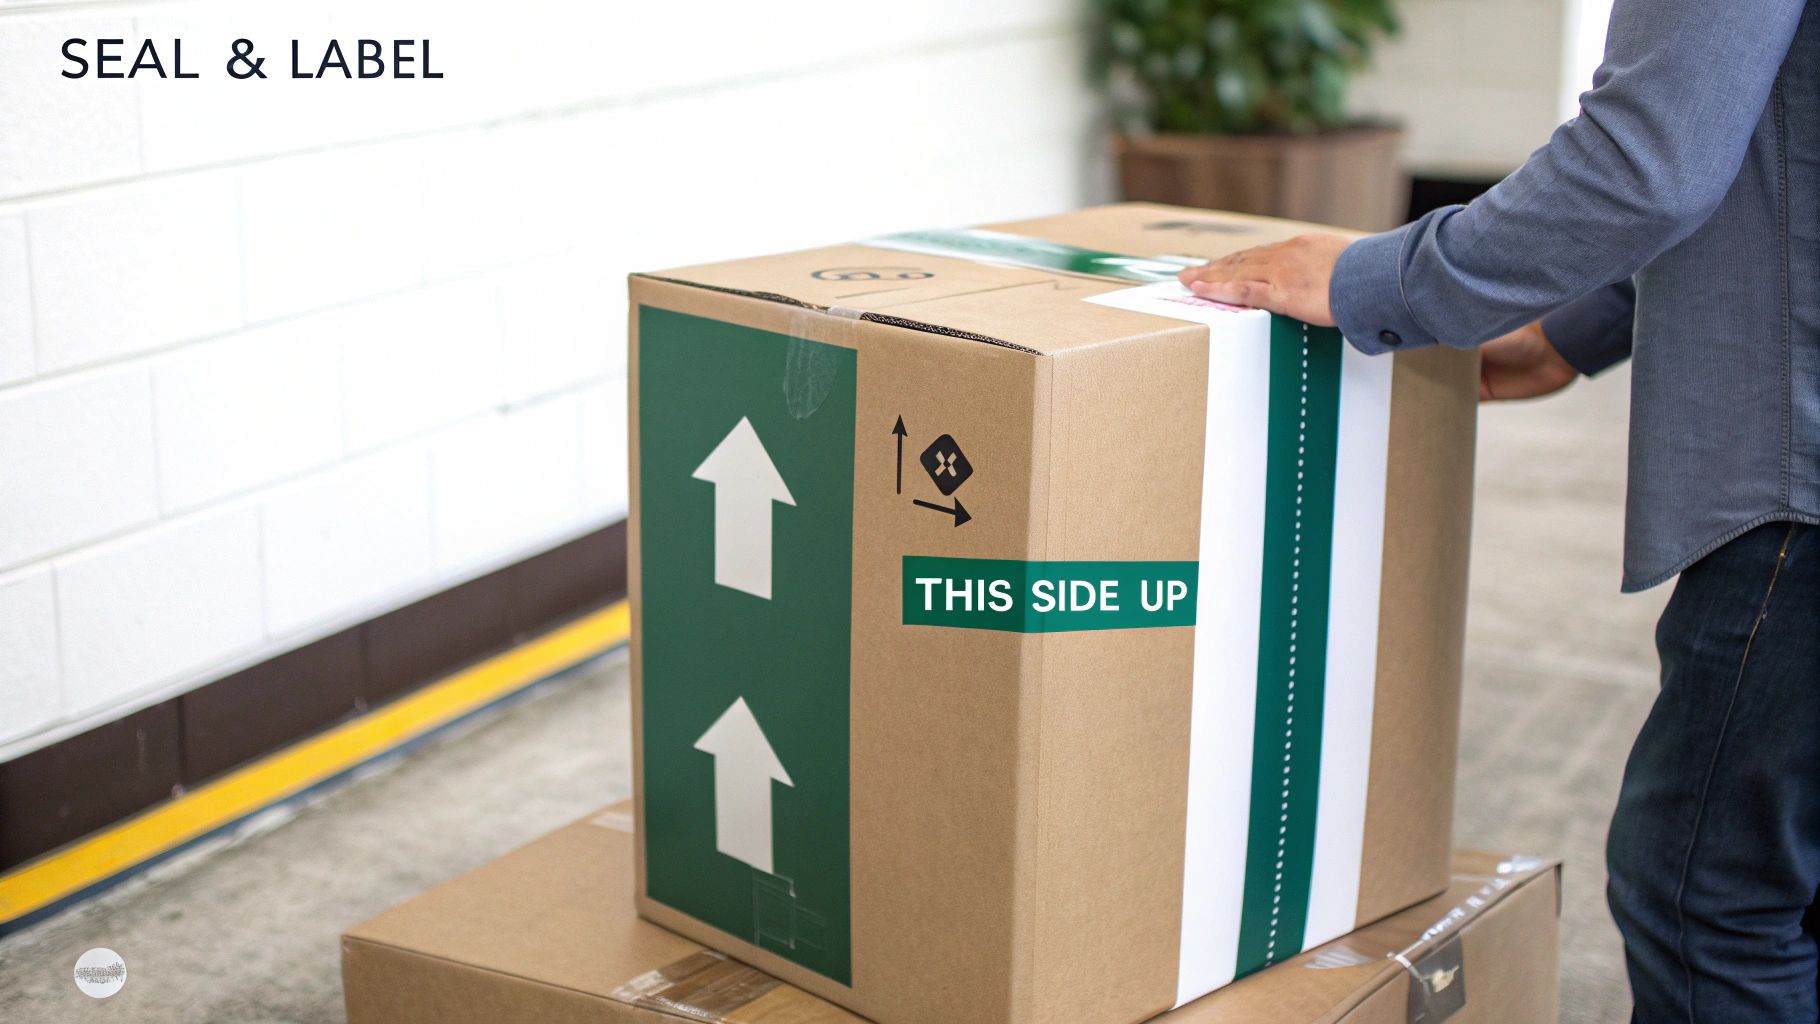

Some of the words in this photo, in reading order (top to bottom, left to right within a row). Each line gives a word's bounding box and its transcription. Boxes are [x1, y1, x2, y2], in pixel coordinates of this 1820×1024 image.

[915, 577, 1014, 612] THIS
[1031, 579, 1120, 613] SIDE
[1141, 579, 1188, 612] UP
